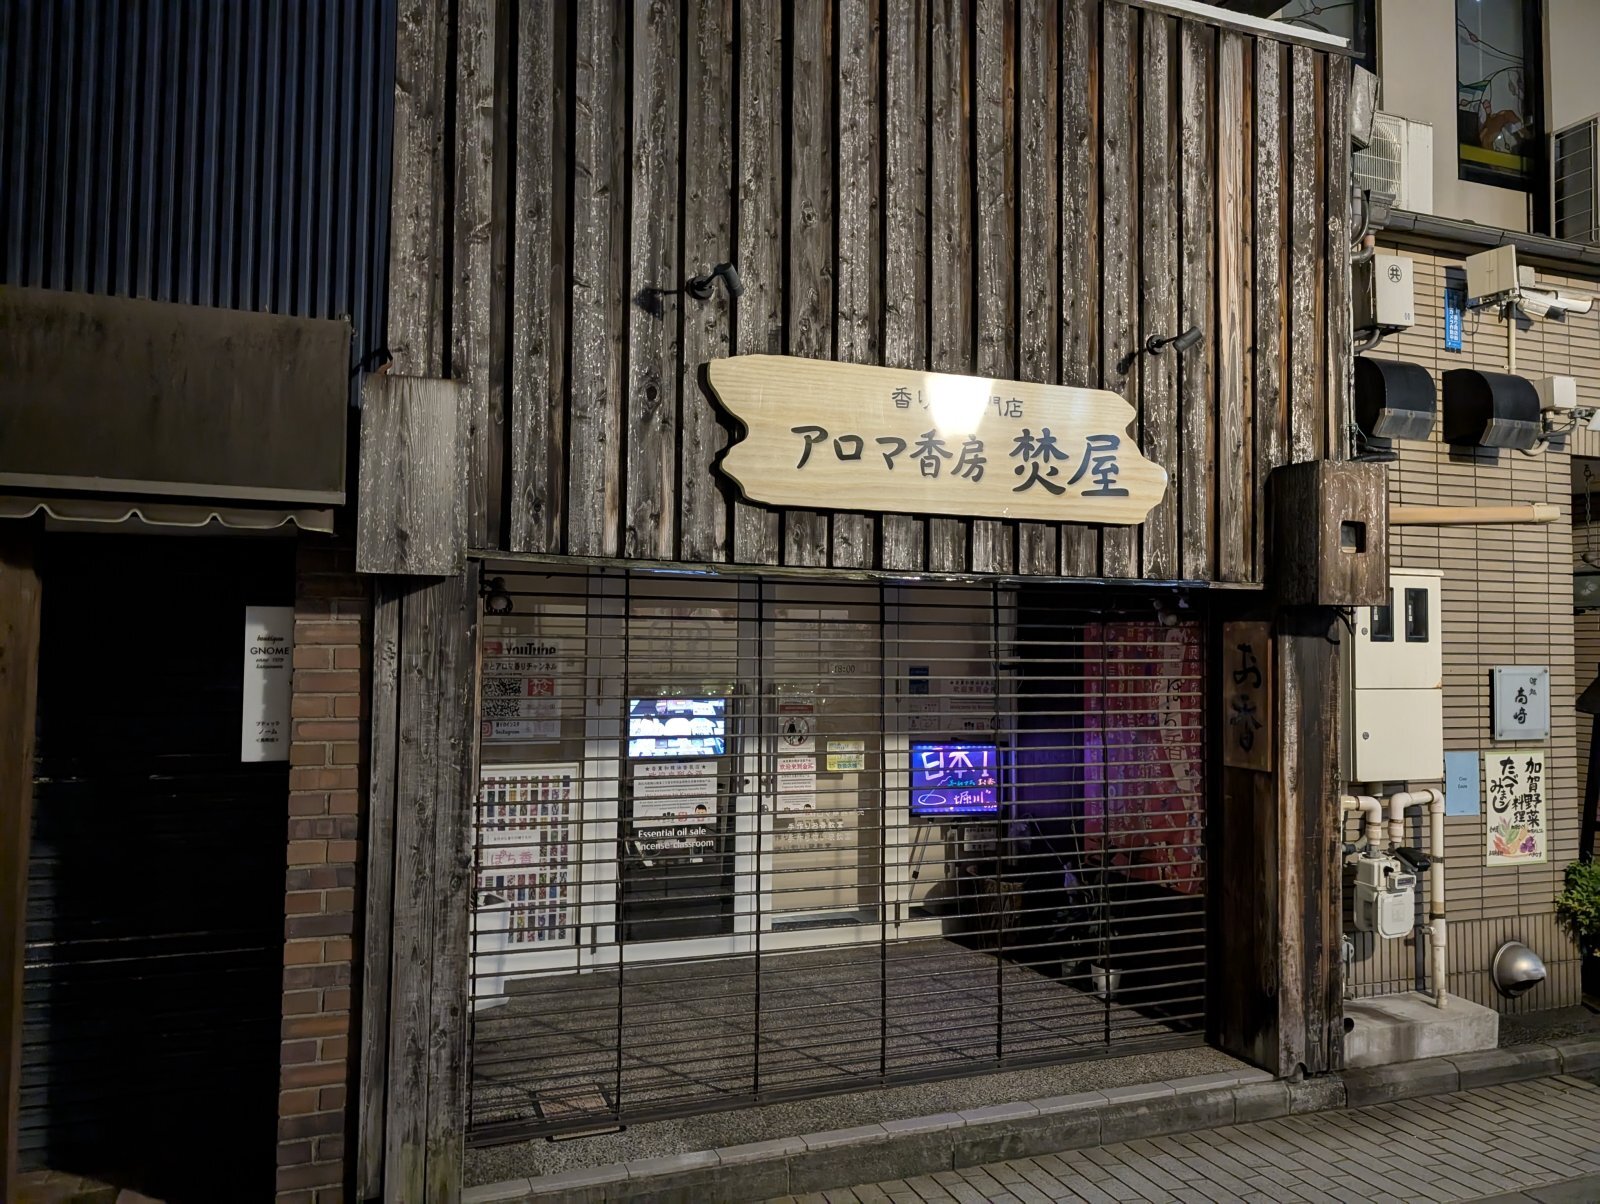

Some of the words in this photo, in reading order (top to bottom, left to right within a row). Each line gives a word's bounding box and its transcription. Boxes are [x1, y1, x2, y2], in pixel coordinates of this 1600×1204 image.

[891, 387, 1024, 418] 香り門店
[790, 425, 987, 482] アロマ香房
[1008, 427, 1130, 497] 焚屋
[250, 646, 290, 655] GNOME
[505, 642, 556, 656] YouTube
[1525, 756, 1542, 828] 加賀野菜
[1512, 795, 1526, 824] 料理
[638, 827, 675, 838] Essential
[676, 827, 687, 836] oil
[689, 826, 707, 835] sale
[673, 839, 714, 848] classroom
